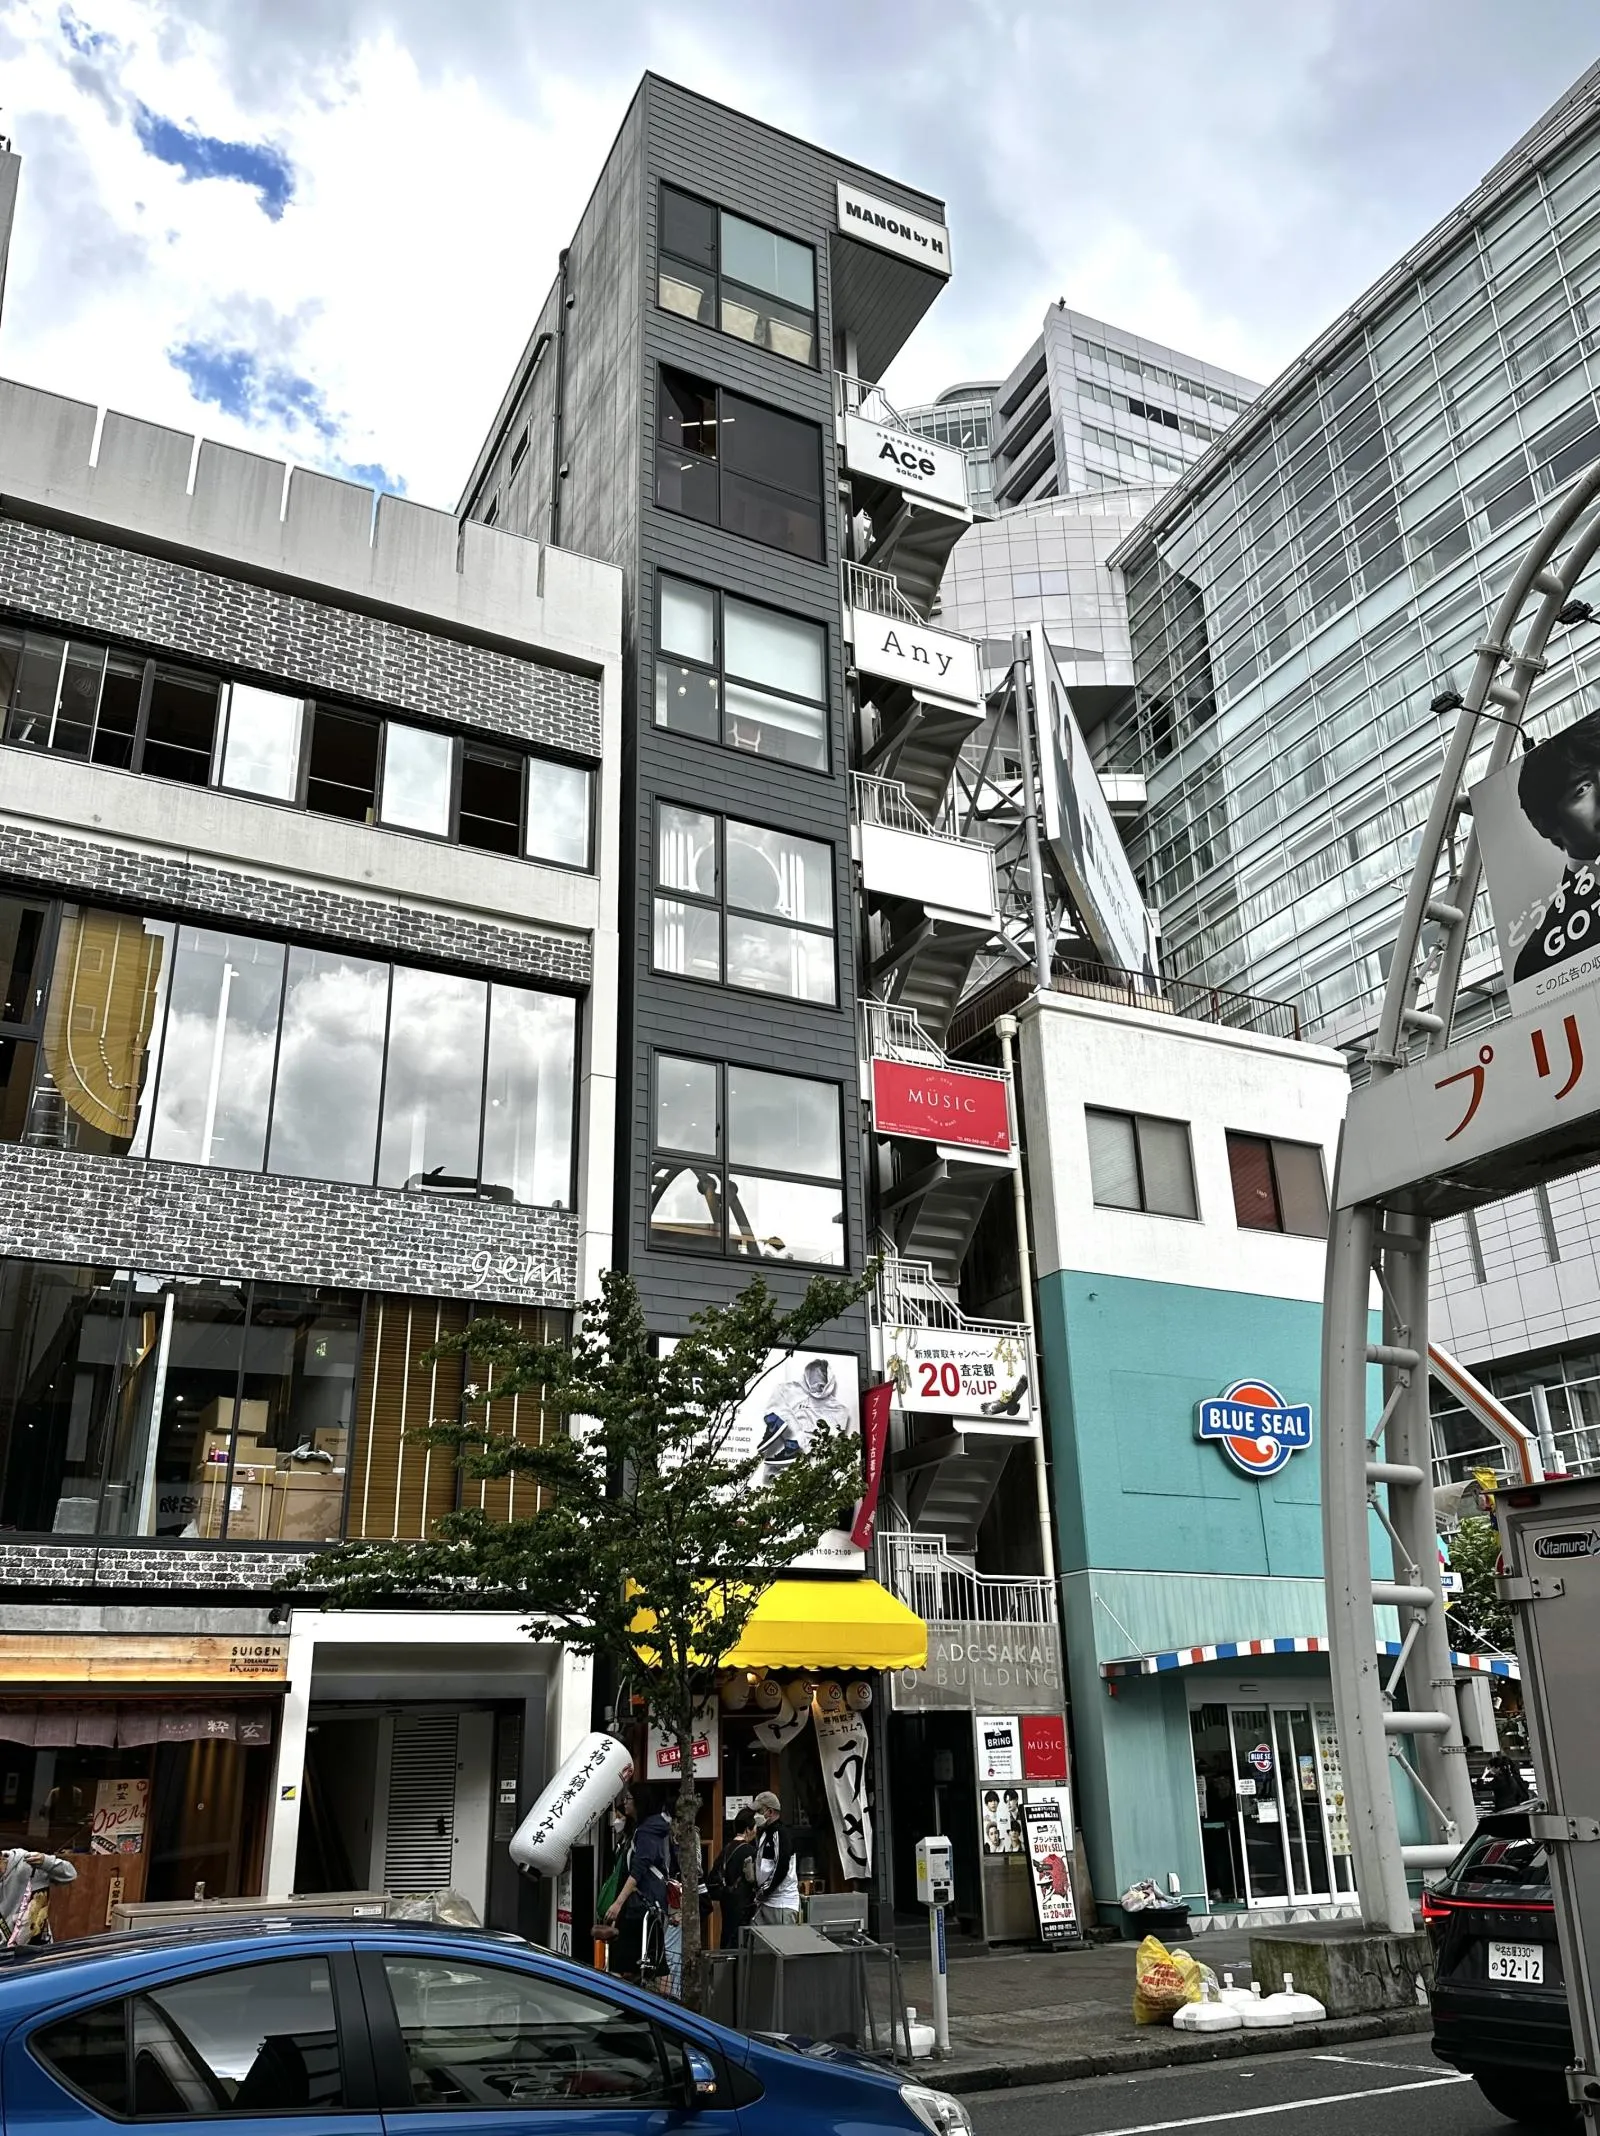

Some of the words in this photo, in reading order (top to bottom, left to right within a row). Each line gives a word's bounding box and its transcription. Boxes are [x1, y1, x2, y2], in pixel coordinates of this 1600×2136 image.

[846, 201, 911, 240] MANON
[913, 230, 928, 247] by
[931, 237, 943, 254] H
[878, 442, 936, 476] Ace
[881, 630, 953, 676] Any
[466, 1251, 562, 1290] gem
[914, 1349, 994, 1360] 新規買取キャンペーン
[918, 1362, 961, 1397] 20
[960, 1363, 995, 1378] 査定額
[961, 1380, 998, 1396] %UP
[1210, 1408, 1255, 1432] BLUE
[1261, 1413, 1306, 1437] SEAL
[1538, 1538, 1587, 1556] Kitamura
[232, 1646, 281, 1656] SUIGEN
[936, 1643, 981, 1663] ADC
[987, 1643, 1056, 1665] SAKAE
[937, 1666, 1059, 1690] BUILDING
[987, 1737, 1012, 1748] BRING
[532, 1739, 613, 1845] 名物大鍋煮込み串
[1491, 1962, 1499, 1972] の
[1500, 1958, 1541, 1981] 92-12
